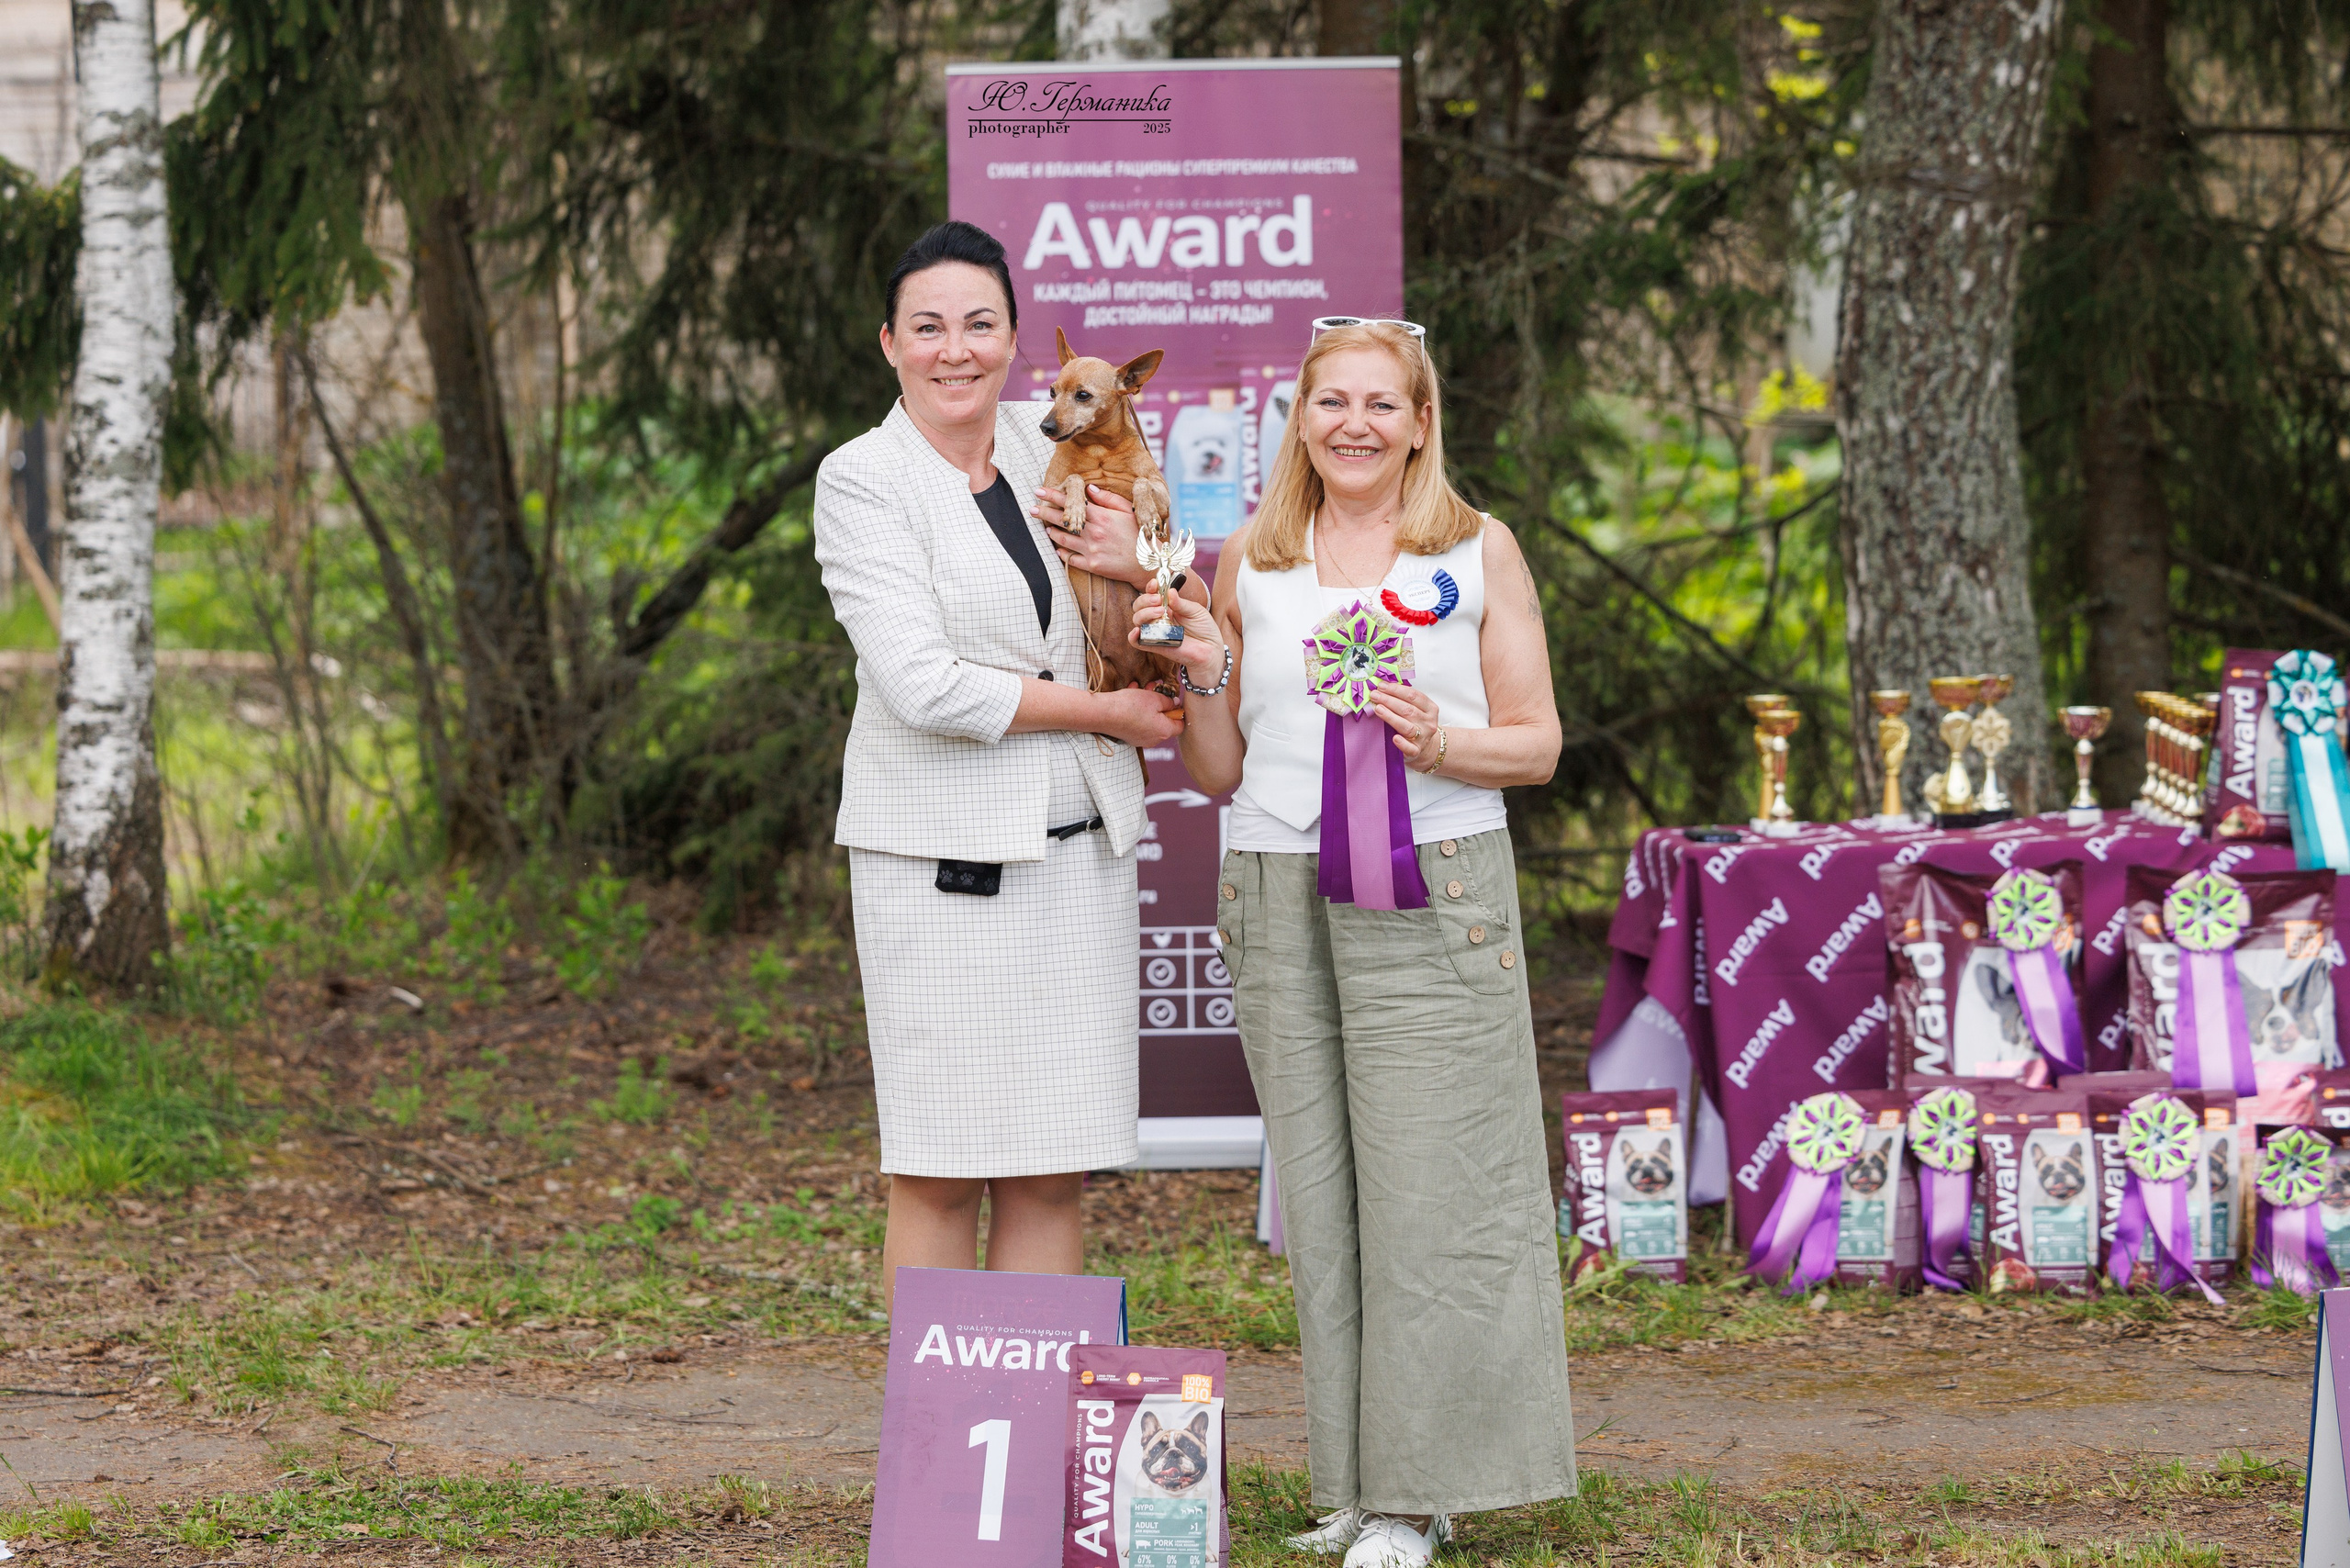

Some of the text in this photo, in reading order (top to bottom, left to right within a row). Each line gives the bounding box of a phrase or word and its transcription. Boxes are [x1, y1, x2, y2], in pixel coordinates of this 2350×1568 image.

[1045, 160, 1113, 178] ВЛАЖНЫЕ
[1114, 160, 1181, 179] РАЦИОНЫ
[1291, 157, 1359, 174] КАЧЕСТВА
[1023, 194, 1314, 271] Award
[1033, 277, 1112, 305] КАЖДЫЙ
[1113, 280, 1194, 303] ПИТОМЕЦ
[1209, 280, 1242, 300] ЭТО
[1243, 278, 1328, 301] ЧЕМПИОН,
[1083, 302, 1274, 329] ДОСТОЙНЫЙ НАГРАДЫ!
[2225, 685, 2257, 800] Award
[1715, 896, 1789, 986] Award
[1805, 891, 1884, 983] Award
[1902, 941, 1947, 1076] ward
[1725, 998, 1796, 1090] Award
[1812, 994, 1888, 1084] Award
[1570, 1131, 1606, 1248] Award
[1982, 1134, 2020, 1251] Award
[957, 1324, 994, 1333] QUALITY
[1018, 1327, 1073, 1337] CHAMPIONS
[1184, 1376, 1210, 1388] 100%
[1184, 1387, 1209, 1400] BIO
[1075, 1413, 1083, 1460] CHAMPIONS
[968, 1418, 1012, 1541] 1
[1074, 1399, 1114, 1558] Award
[1135, 1521, 1158, 1529] ADULT
[1154, 1539, 1174, 1547] PORK
[1137, 1554, 1151, 1564] 67%
[1167, 1554, 1177, 1564] 0%
[1190, 1555, 1200, 1565] 0%
